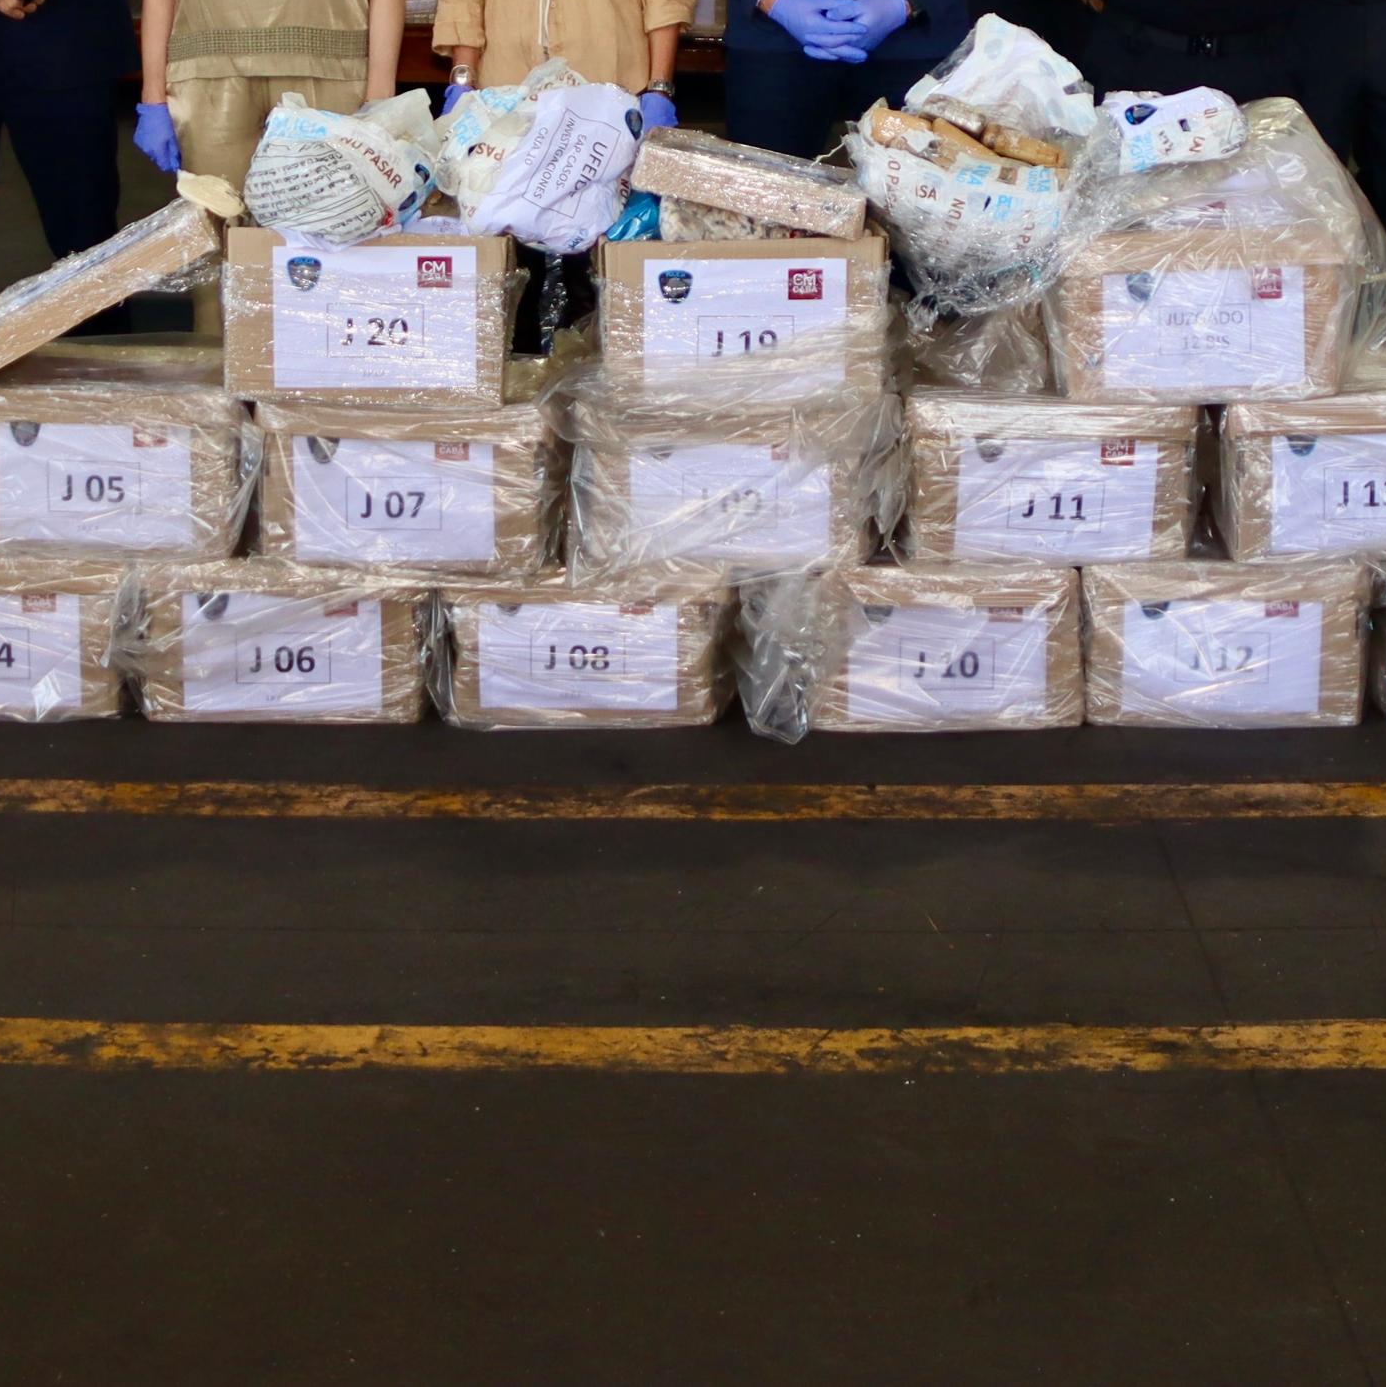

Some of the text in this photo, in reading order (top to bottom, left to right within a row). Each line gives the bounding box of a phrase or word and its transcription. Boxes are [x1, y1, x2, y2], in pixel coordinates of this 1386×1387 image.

[363, 146, 403, 190] PASAR
[533, 116, 575, 200] INVESTIGACIONES
[421, 260, 446, 274] CM
[792, 272, 818, 286] CM
[341, 317, 409, 346] J 20
[711, 329, 778, 358] J 19
[1182, 335, 1202, 351] 12
[439, 446, 465, 455] CABA
[61, 474, 125, 504] J 05
[1337, 481, 1350, 508] J
[361, 490, 426, 519] J 07
[1021, 493, 1087, 522] J 11
[249, 645, 316, 674] J 06
[544, 643, 611, 672] J 08
[913, 650, 981, 680] J 10
[1189, 646, 1255, 673] J 12
